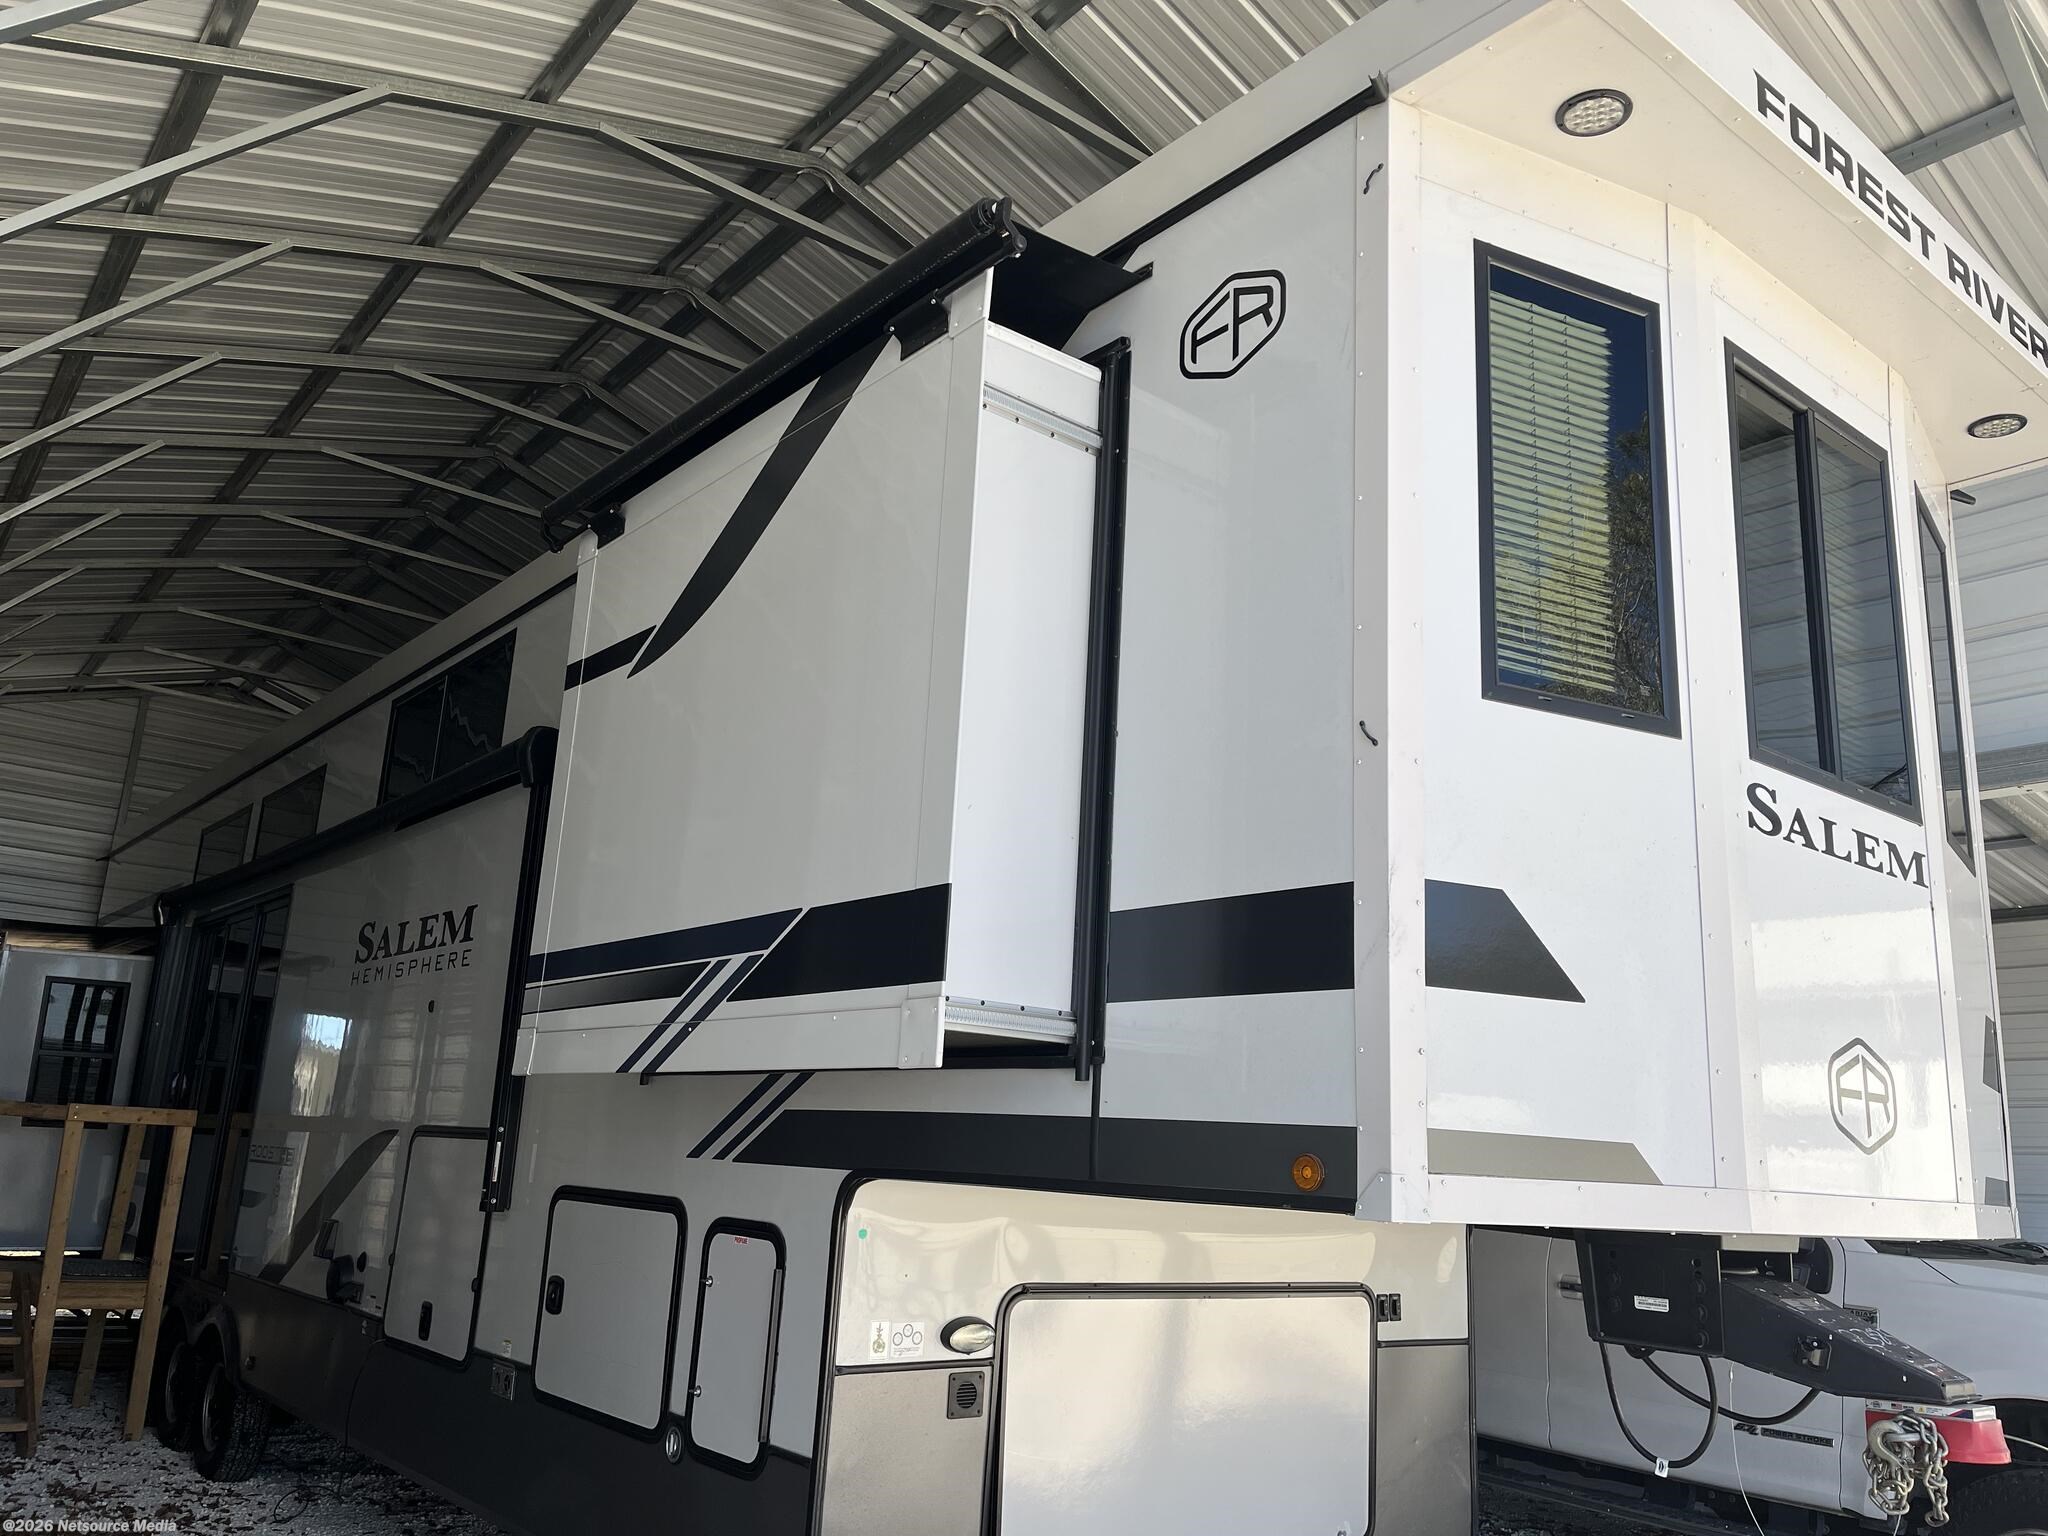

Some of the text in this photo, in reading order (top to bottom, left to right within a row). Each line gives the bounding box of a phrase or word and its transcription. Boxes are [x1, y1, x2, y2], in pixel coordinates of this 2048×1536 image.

[1753, 68, 2048, 369] FOREST RIVER
[1746, 782, 1929, 889] SALEM
[350, 948, 472, 986] HEMISPHERE
[354, 904, 479, 964] SALEM
